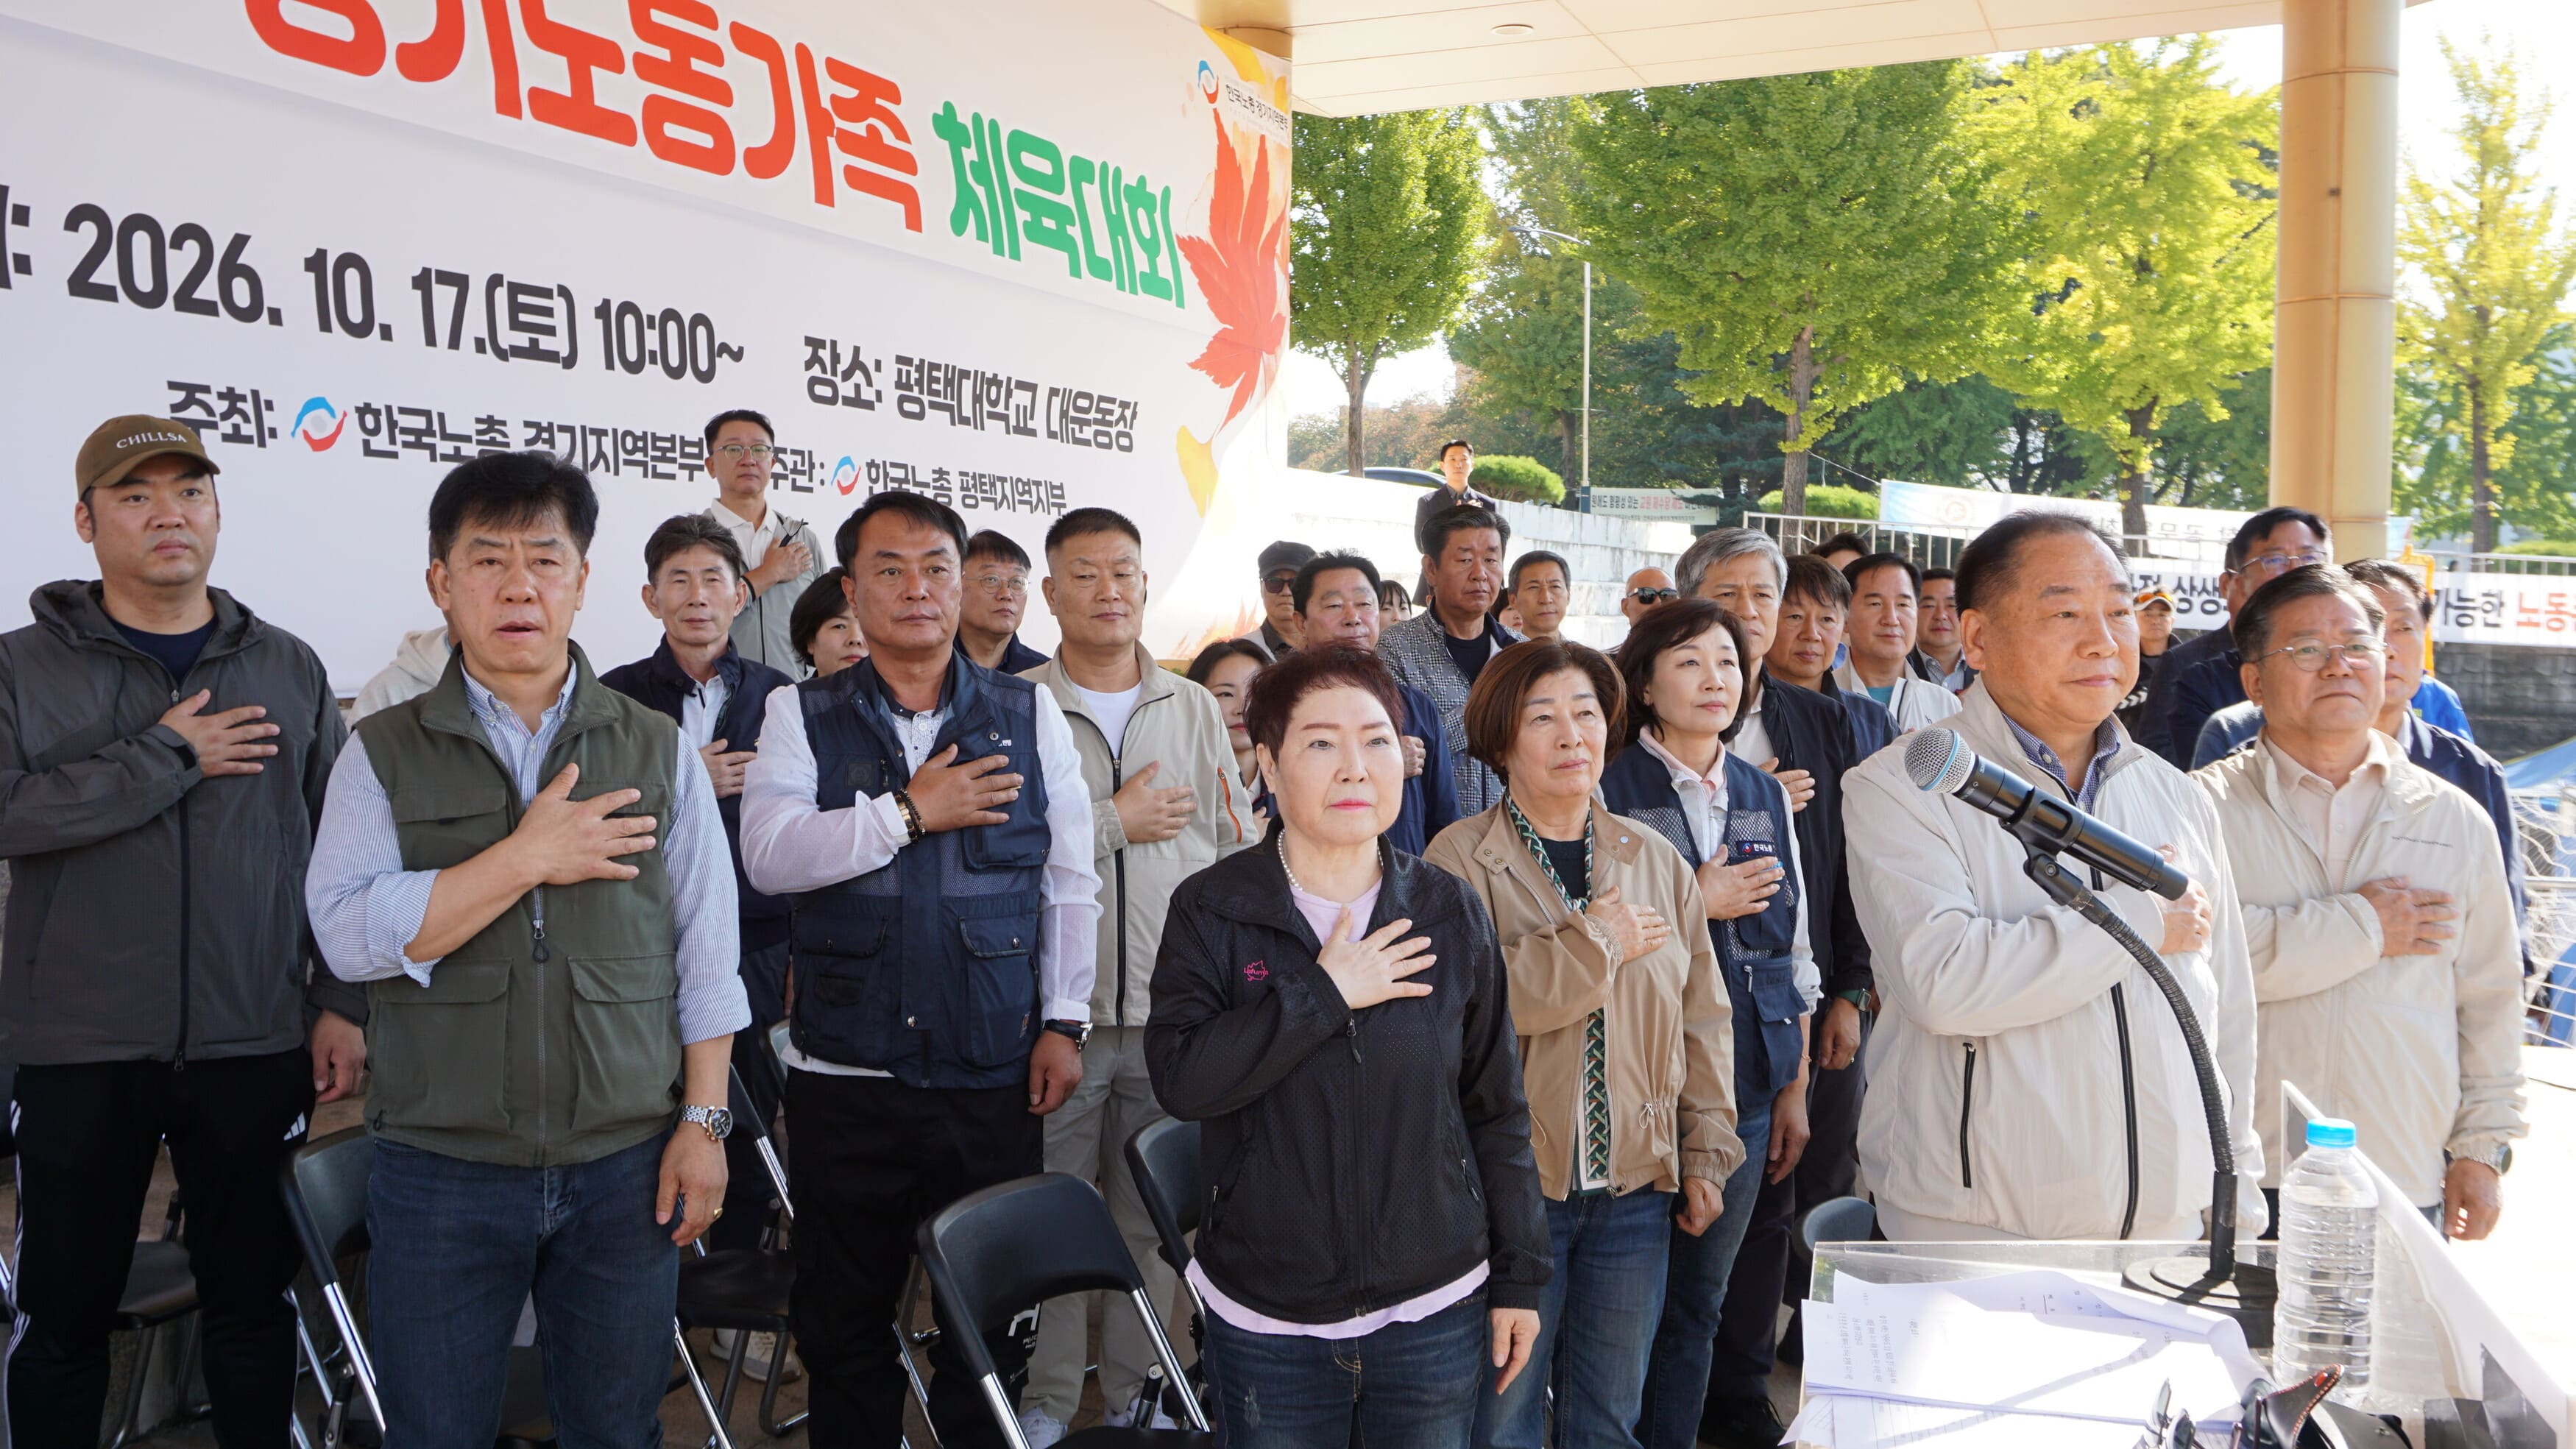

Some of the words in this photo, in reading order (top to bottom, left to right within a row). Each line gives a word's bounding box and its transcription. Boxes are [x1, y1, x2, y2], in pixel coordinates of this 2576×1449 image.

[1225, 84, 1256, 113] 한국노총
[932, 100, 1186, 310] 체육대회
[63, 202, 283, 327] 2026.
[303, 247, 393, 342] 10.
[411, 266, 578, 370] 17.(토)
[594, 298, 745, 384] 10:00~
[804, 336, 883, 411] 장소:
[894, 354, 1039, 439] 평택대학교
[1045, 386, 1139, 453] 대운동장
[166, 380, 278, 449] 주최:
[354, 401, 512, 463] 한국노총
[523, 419, 704, 483] 경기지역본부
[958, 471, 1067, 517] 평택지역지부
[2516, 590, 2576, 634] 노동
